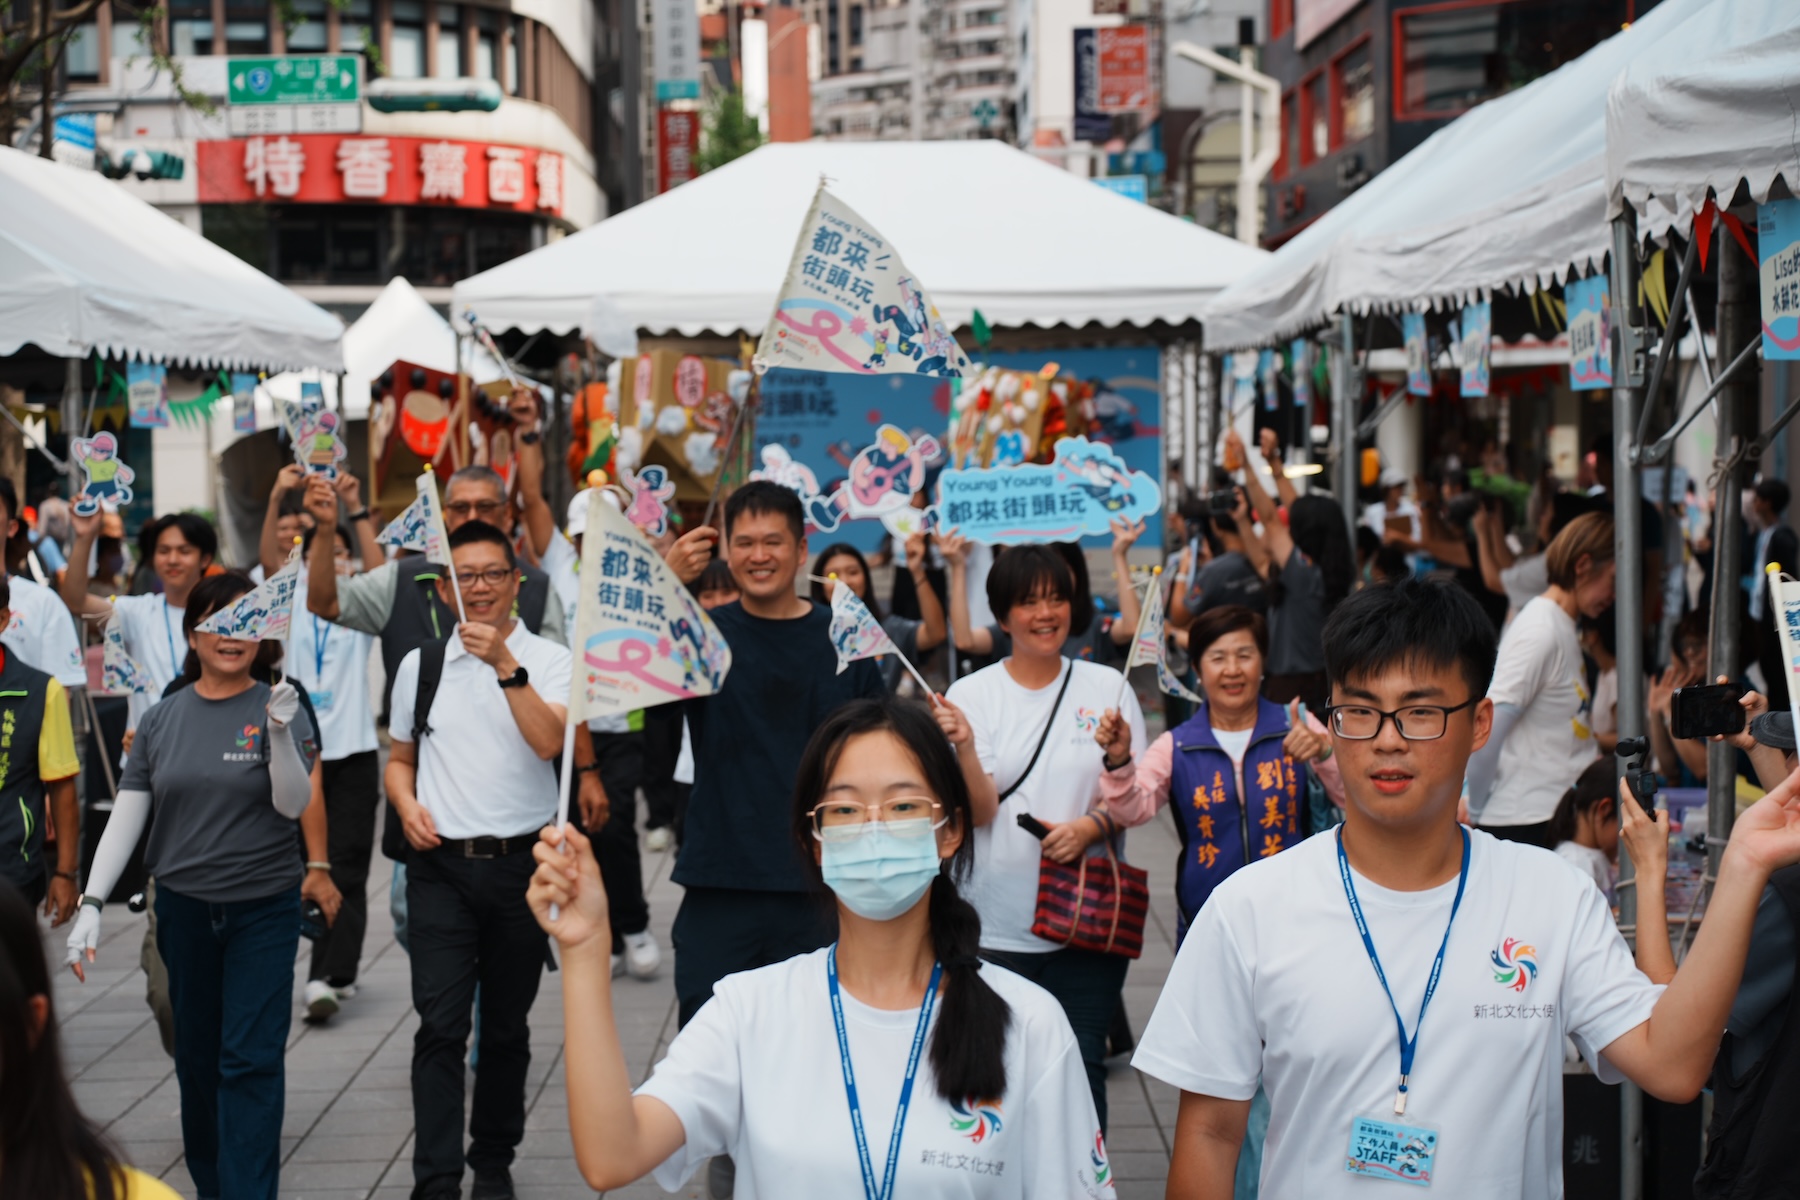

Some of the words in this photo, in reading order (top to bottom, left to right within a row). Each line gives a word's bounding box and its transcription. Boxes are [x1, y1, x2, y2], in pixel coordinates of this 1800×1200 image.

[820, 210, 851, 232] Young
[855, 225, 883, 248] Young
[812, 225, 870, 271] 都來
[802, 254, 874, 304] 街頭玩
[946, 478, 998, 494] Young
[1000, 474, 1053, 490] Young
[948, 491, 1087, 524] 都來街頭玩
[601, 546, 652, 587] 都來
[598, 582, 666, 621] 街頭玩
[1473, 1003, 1556, 1019] 新北文化大使
[1356, 1146, 1398, 1164] STAFF
[1357, 1135, 1399, 1151] 工作人員
[1571, 1134, 1600, 1165] 兆
[920, 1149, 1005, 1177] 新北文化大使
